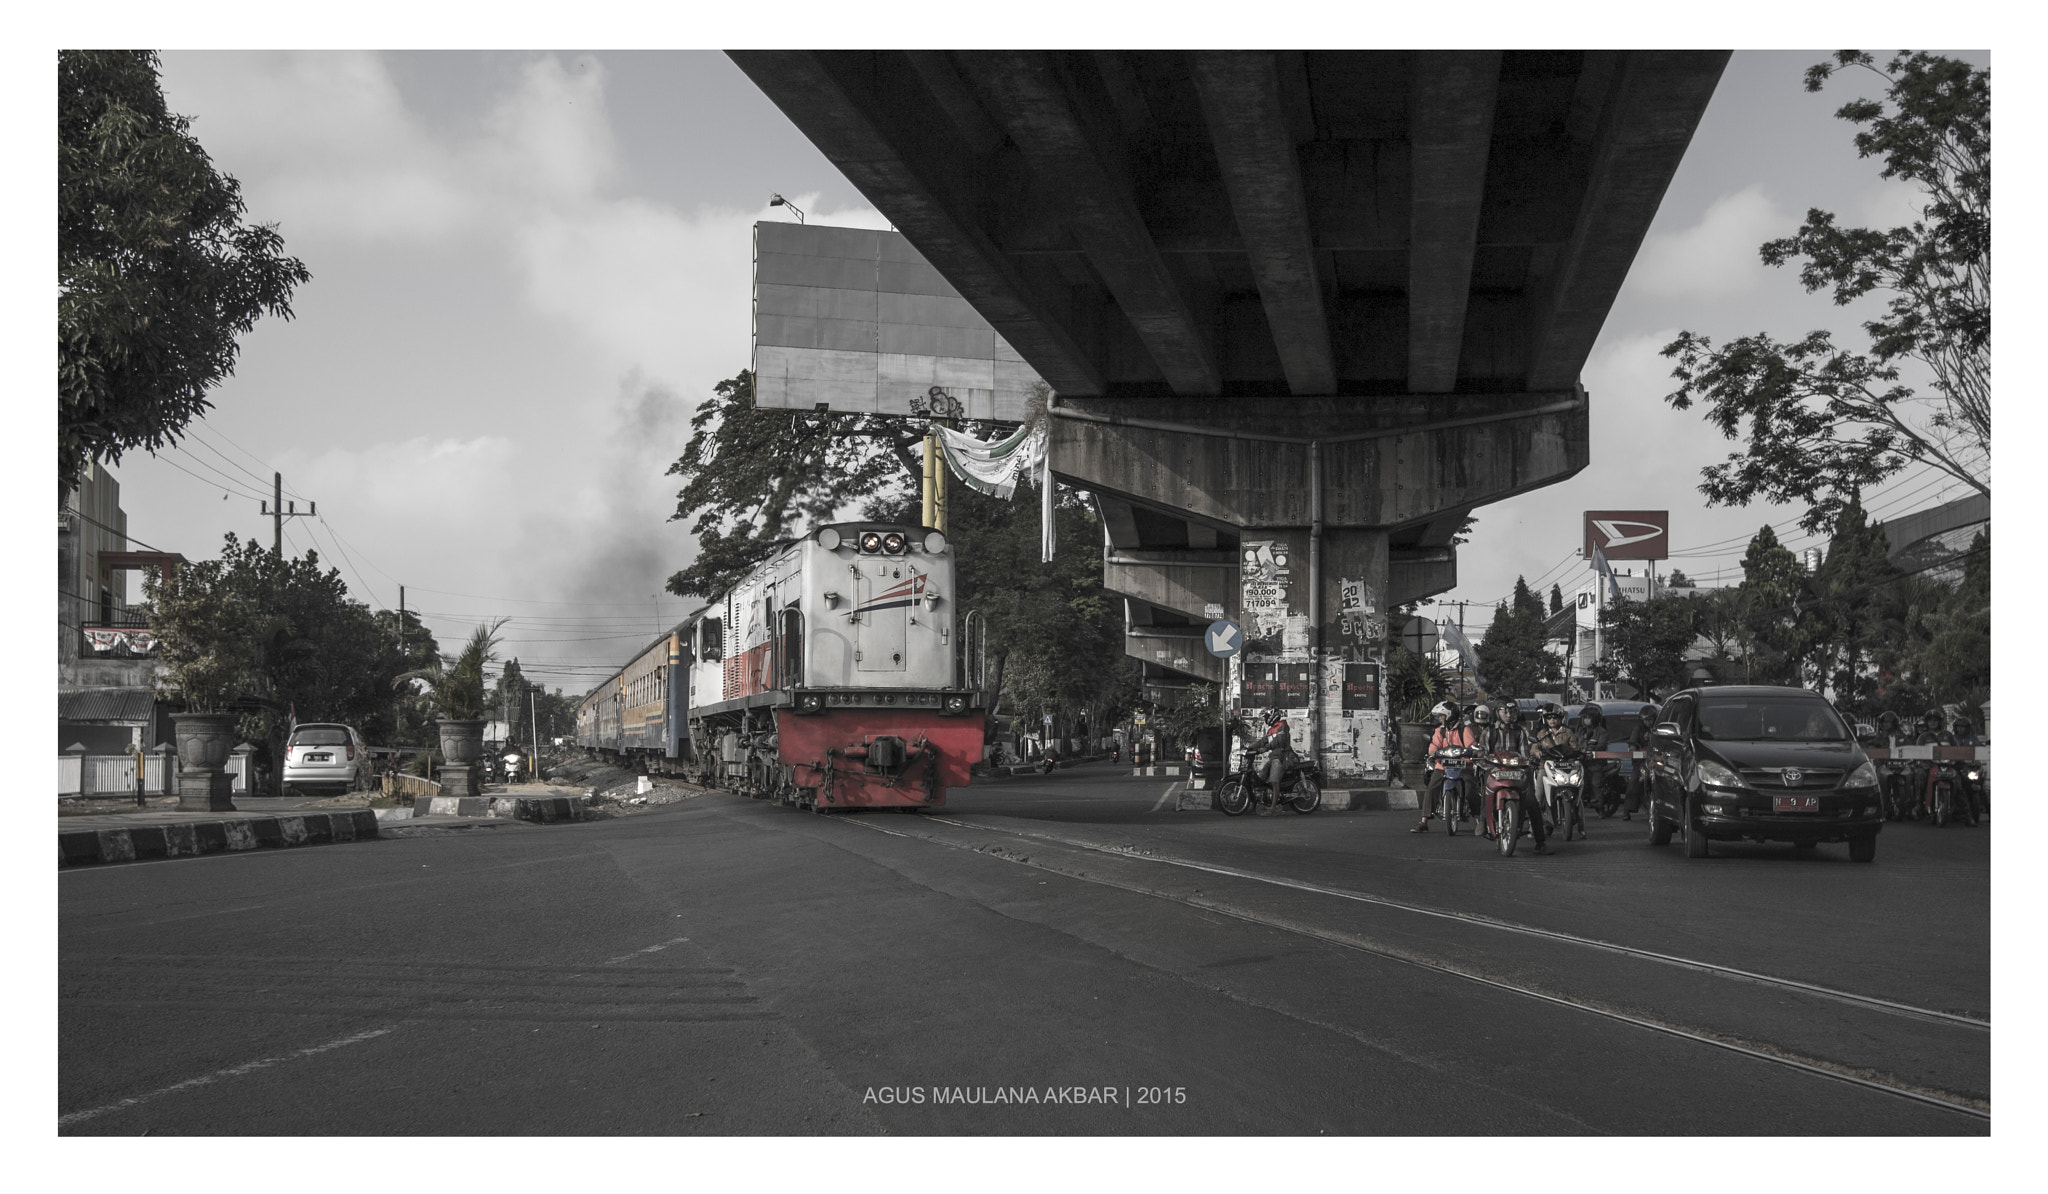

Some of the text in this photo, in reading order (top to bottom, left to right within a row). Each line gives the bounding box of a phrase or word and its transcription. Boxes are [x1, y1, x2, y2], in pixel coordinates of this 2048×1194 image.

[1343, 586, 1357, 598] 20
[1346, 683, 1375, 692] Apache
[1805, 798, 1817, 806] AP
